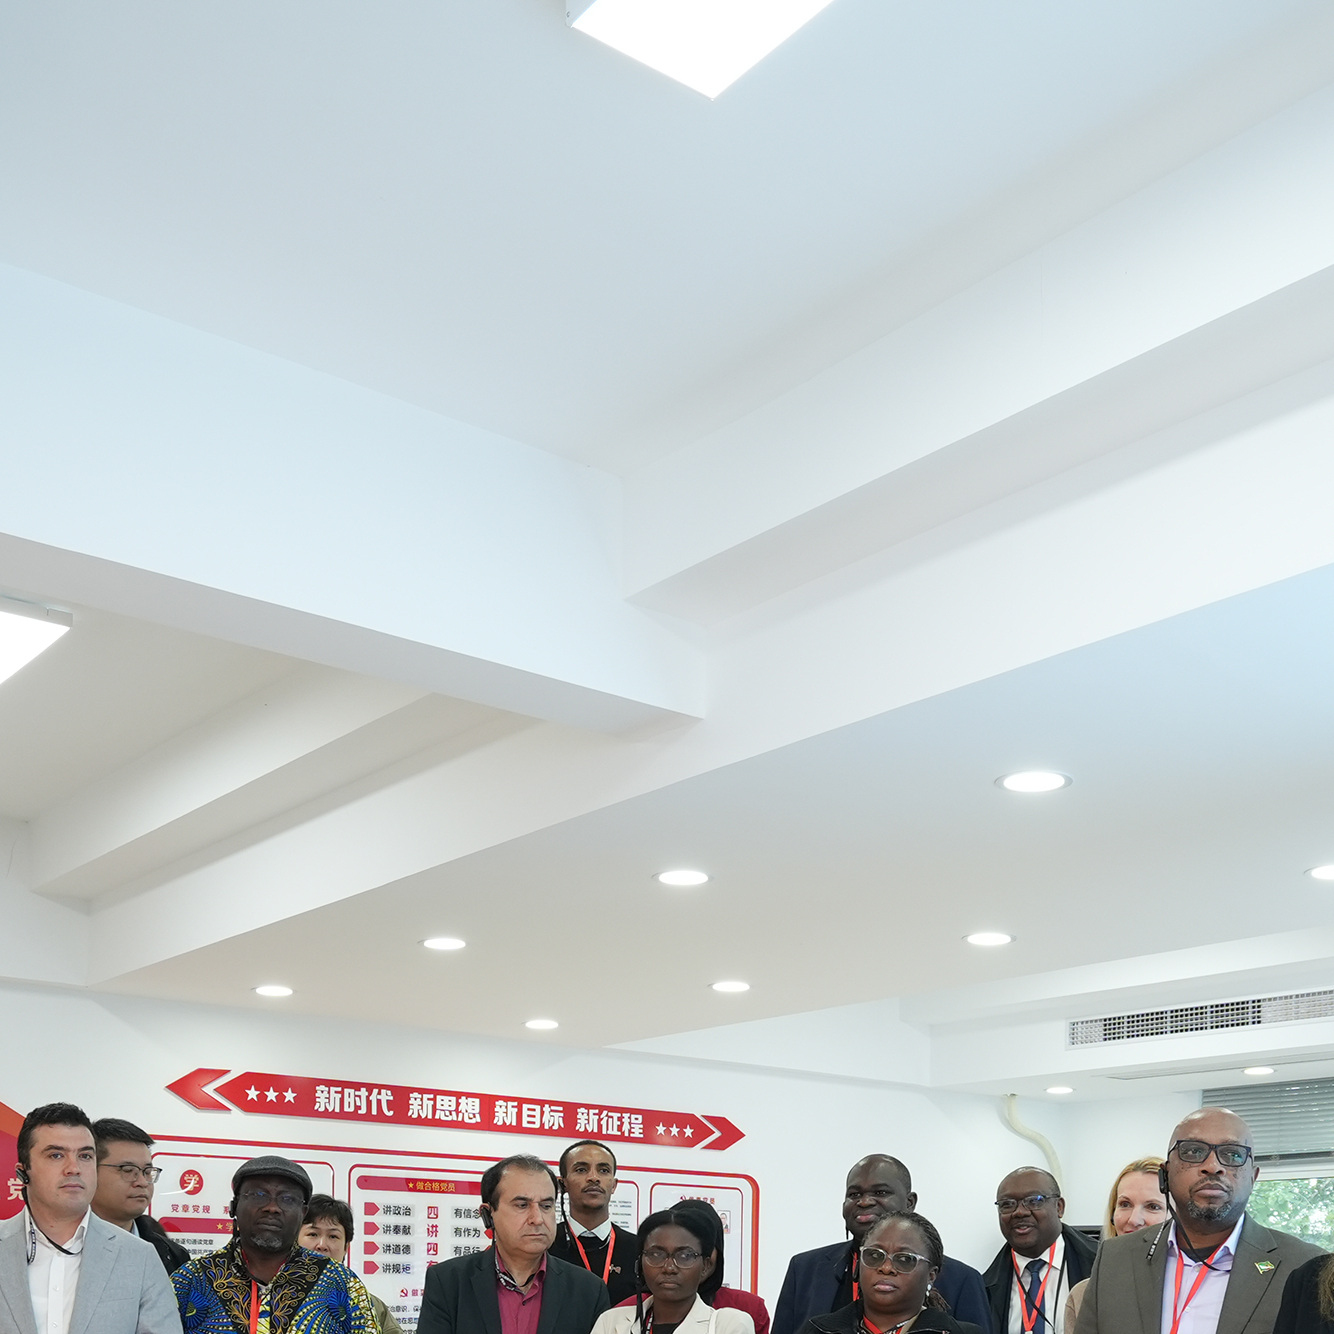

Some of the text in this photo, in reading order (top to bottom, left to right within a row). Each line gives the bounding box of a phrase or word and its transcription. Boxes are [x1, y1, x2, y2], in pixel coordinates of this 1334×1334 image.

[314, 1085, 644, 1138] 新时代 新思想 新目标 新征程
[183, 1173, 200, 1191] 学
[416, 1181, 456, 1192] 做合格党员
[171, 1203, 211, 1214] 党章党规
[382, 1205, 412, 1216] 讲政治
[453, 1208, 481, 1219] 有信念
[382, 1224, 412, 1235] 讲奉献
[453, 1227, 481, 1238] 有作为
[381, 1244, 411, 1255] 讲道德
[381, 1263, 411, 1275] 讲规矩
